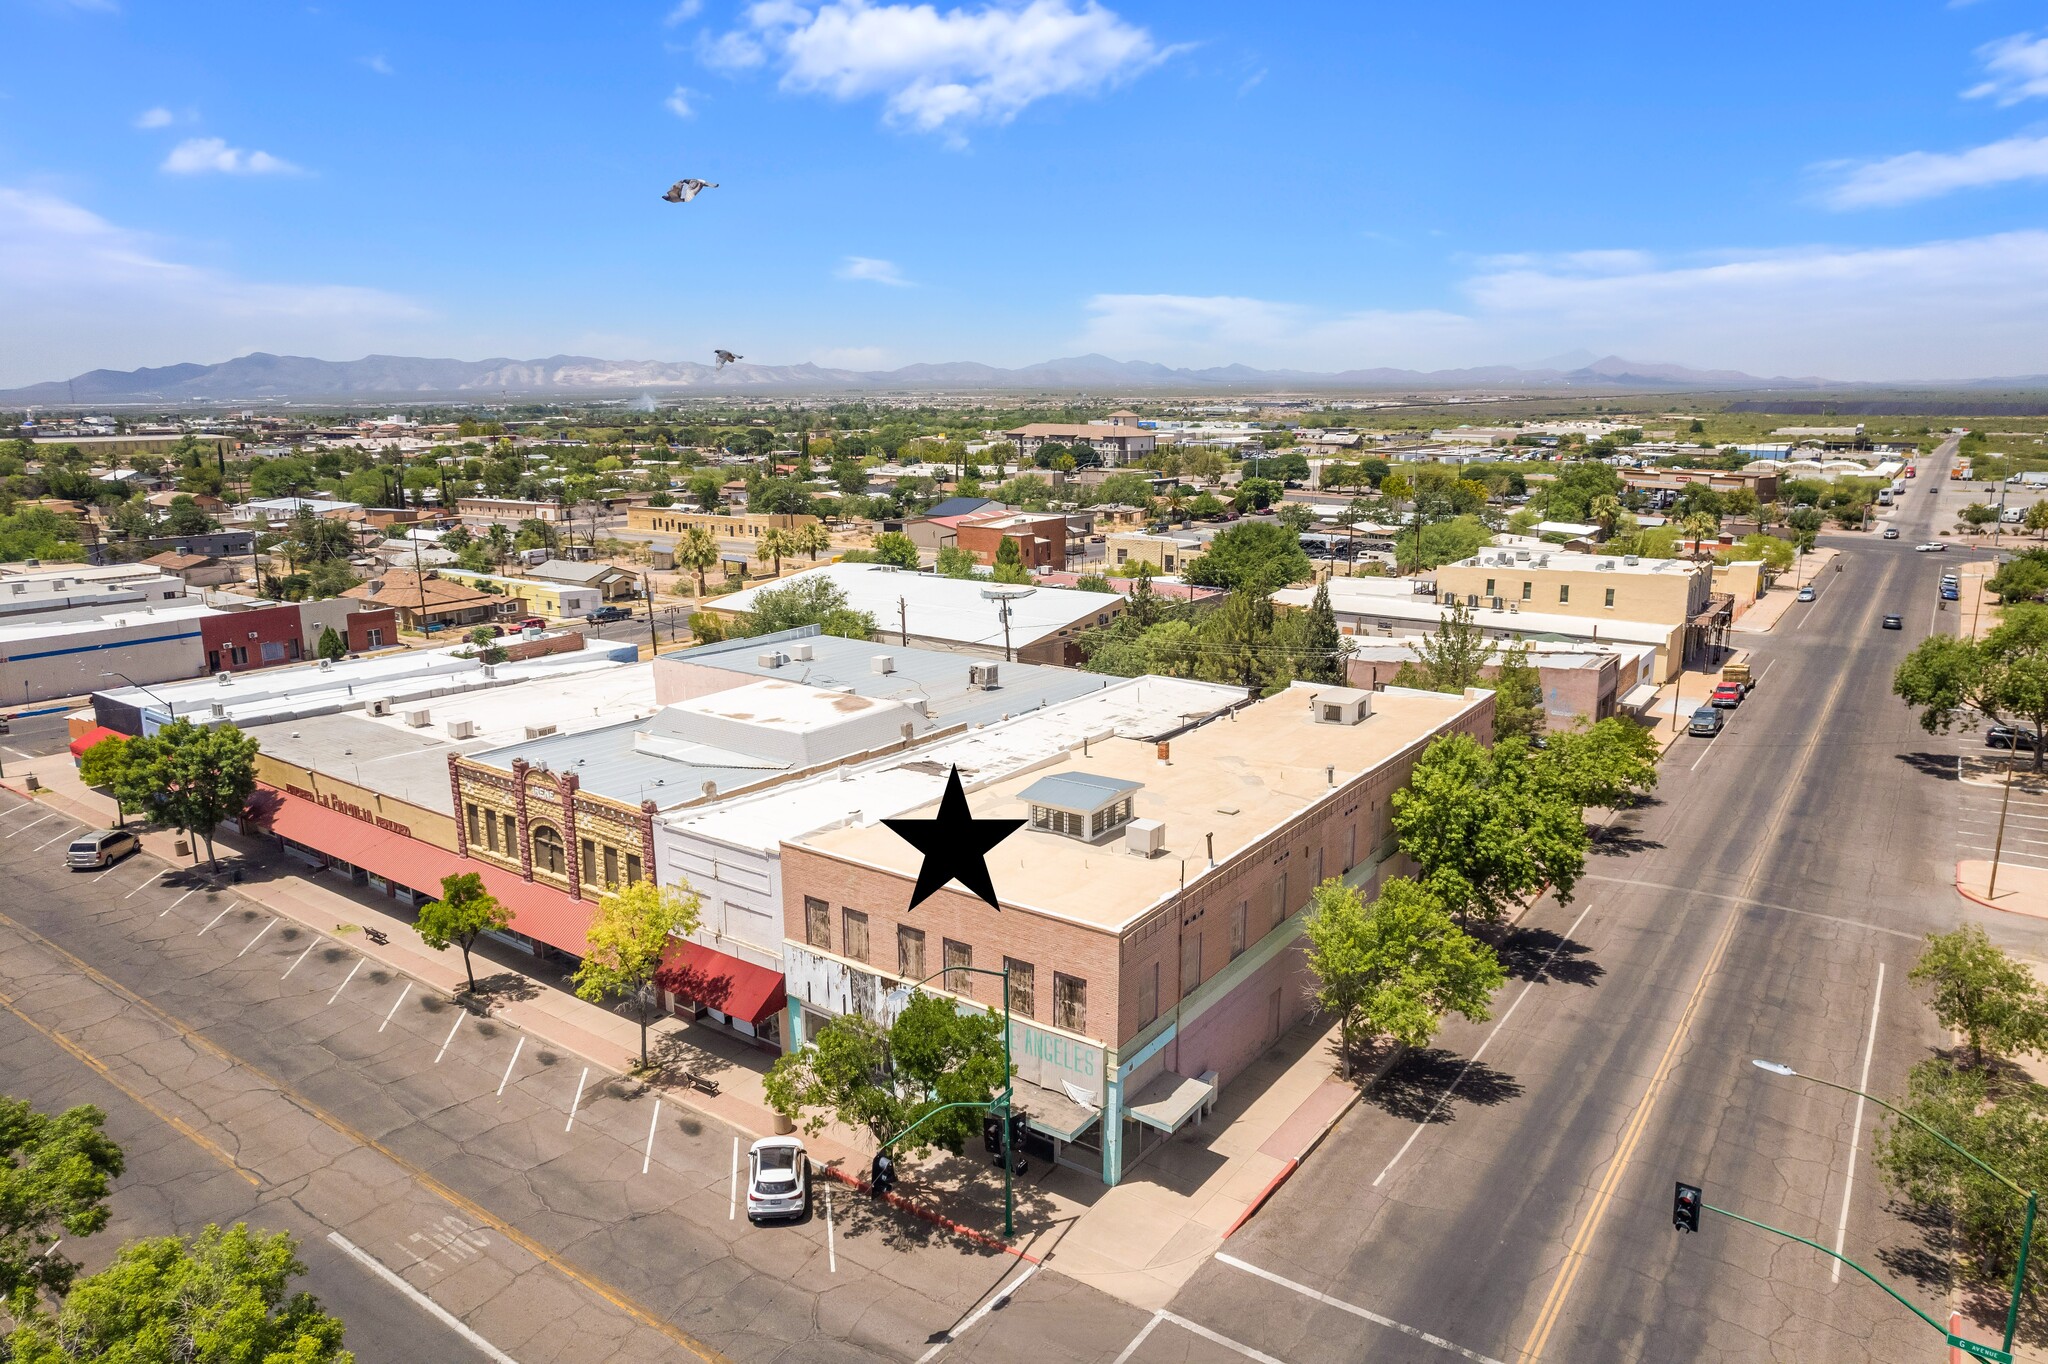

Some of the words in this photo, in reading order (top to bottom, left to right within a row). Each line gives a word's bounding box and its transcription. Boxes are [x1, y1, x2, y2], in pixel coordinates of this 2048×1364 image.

[331, 793, 375, 825] FAMILIA
[1024, 1027, 1094, 1077] ANGELES
[1959, 1340, 1966, 1348] G
[1971, 1345, 1999, 1359] AVENUE
